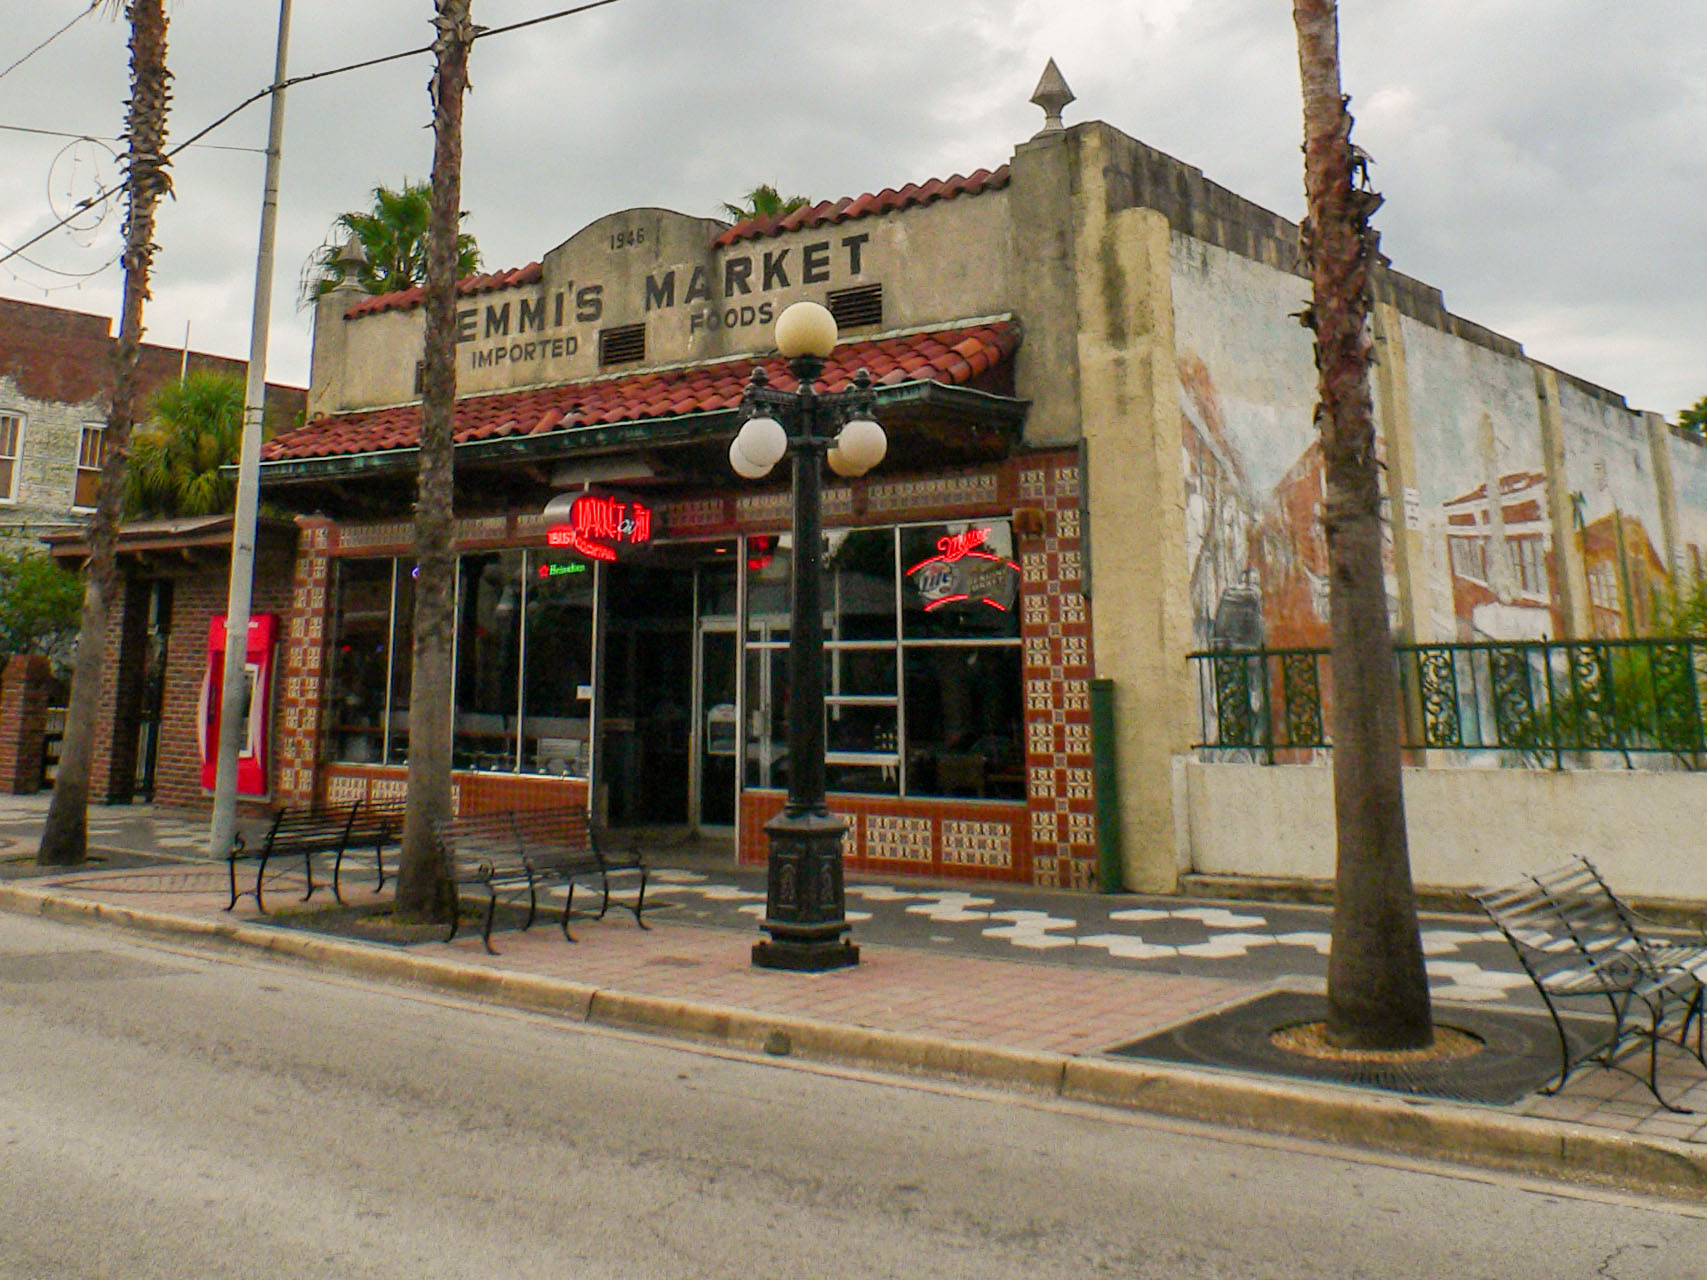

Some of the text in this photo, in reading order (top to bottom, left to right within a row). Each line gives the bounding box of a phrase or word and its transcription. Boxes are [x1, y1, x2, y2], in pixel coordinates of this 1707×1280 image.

[610, 228, 645, 251] 1946
[456, 232, 870, 345] EMMI'S MARKET
[472, 301, 774, 369] IMPORTED FOODS
